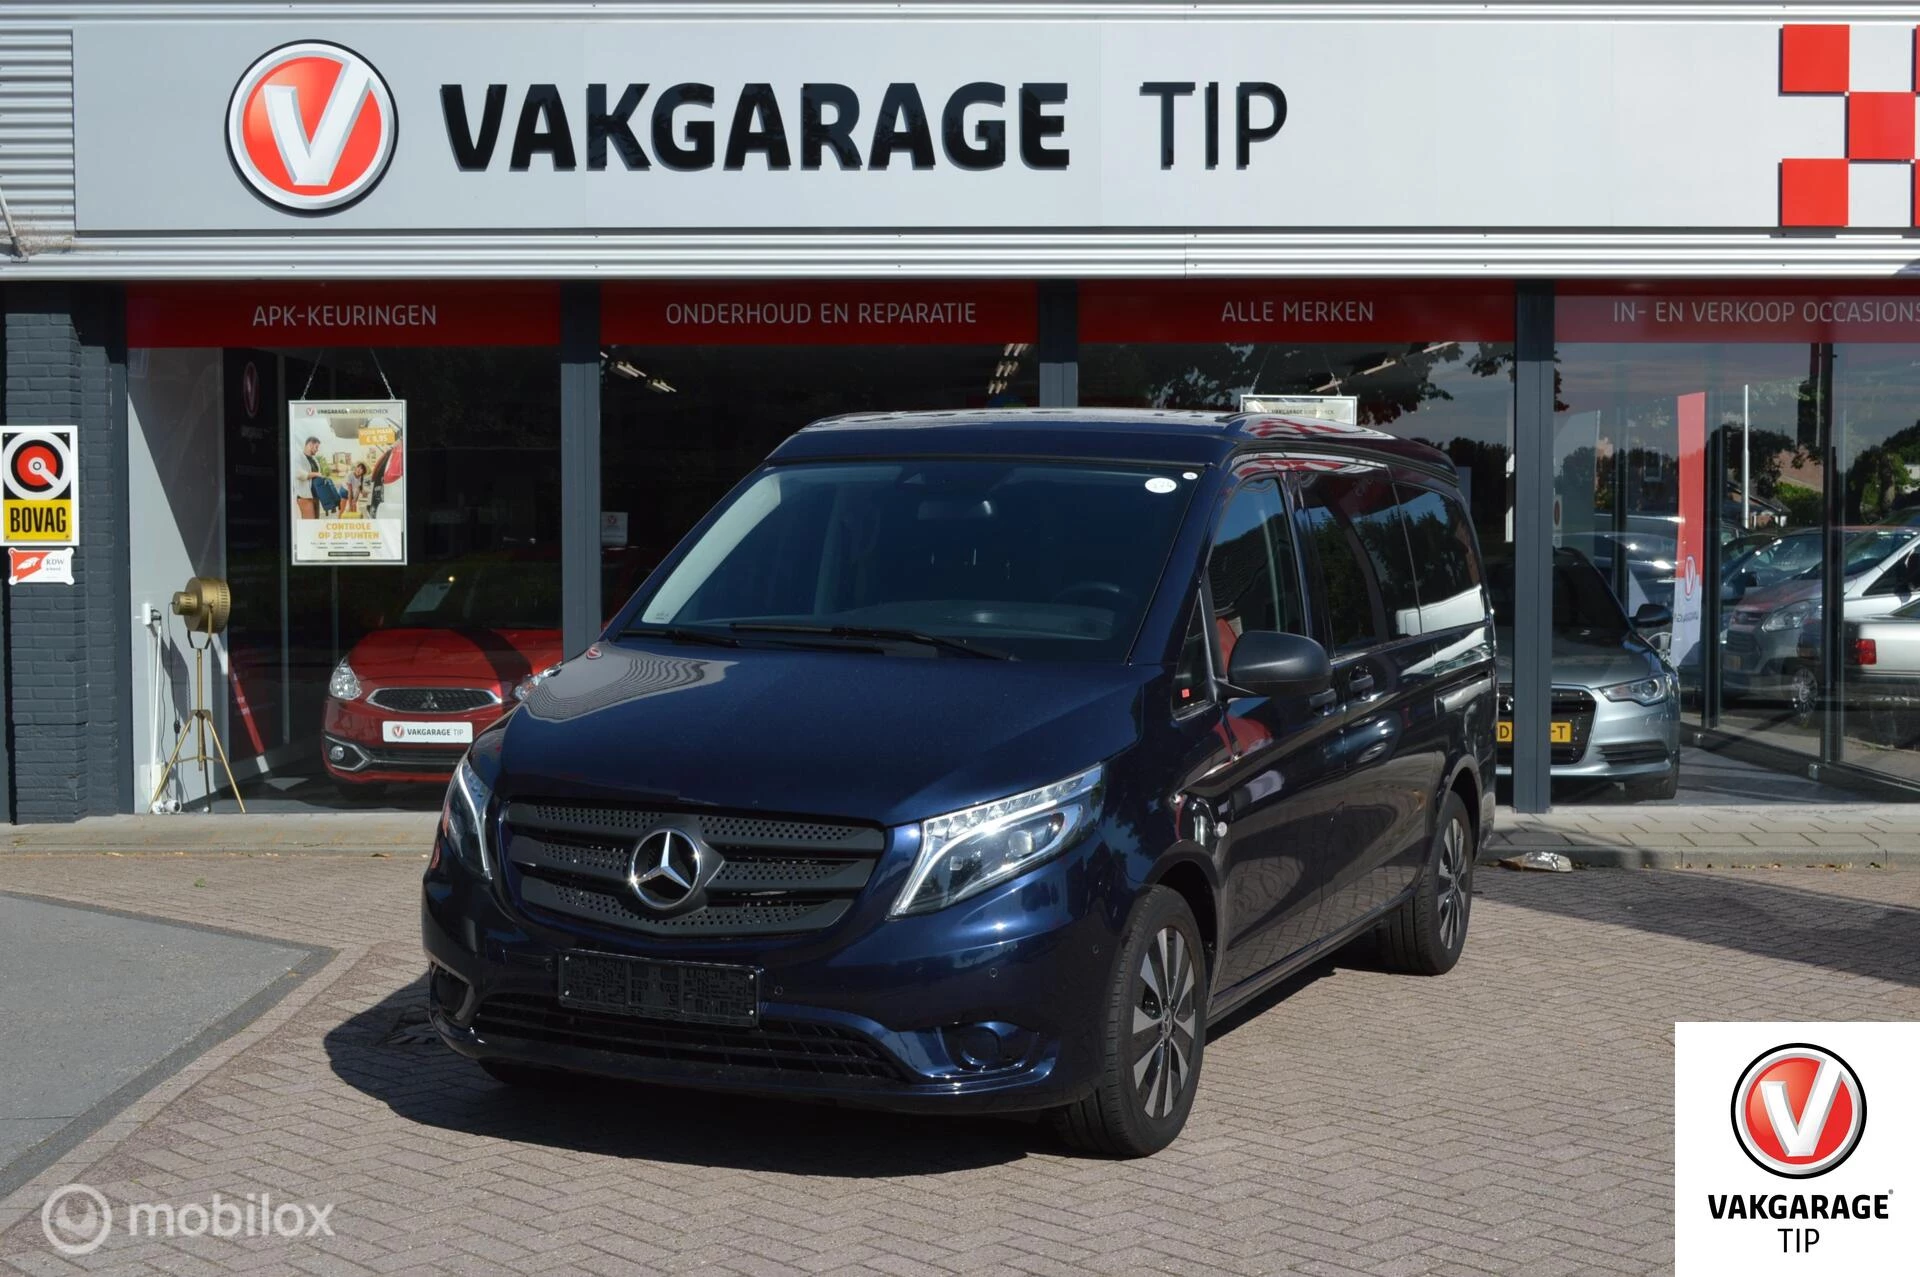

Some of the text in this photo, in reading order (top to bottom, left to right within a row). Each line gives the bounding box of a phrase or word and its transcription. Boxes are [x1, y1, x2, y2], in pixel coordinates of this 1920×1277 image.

[440, 81, 1288, 172] VAKGARAGE TIP
[252, 305, 437, 327] APK-KEURINGEN
[666, 302, 977, 325] ONDERHOUD EN REPARATIE
[1221, 301, 1374, 323] ALLE MERKEN
[1613, 302, 1647, 323] IN-
[1655, 302, 1683, 322] EN
[1692, 301, 1795, 322] VERKOOP
[10, 507, 66, 533] BOVAG
[326, 522, 372, 531] CONTROLE
[318, 531, 330, 540] OP
[344, 531, 380, 540] PUNTEN
[46, 558, 65, 566] RDW
[407, 728, 451, 736] VAKGARAGE
